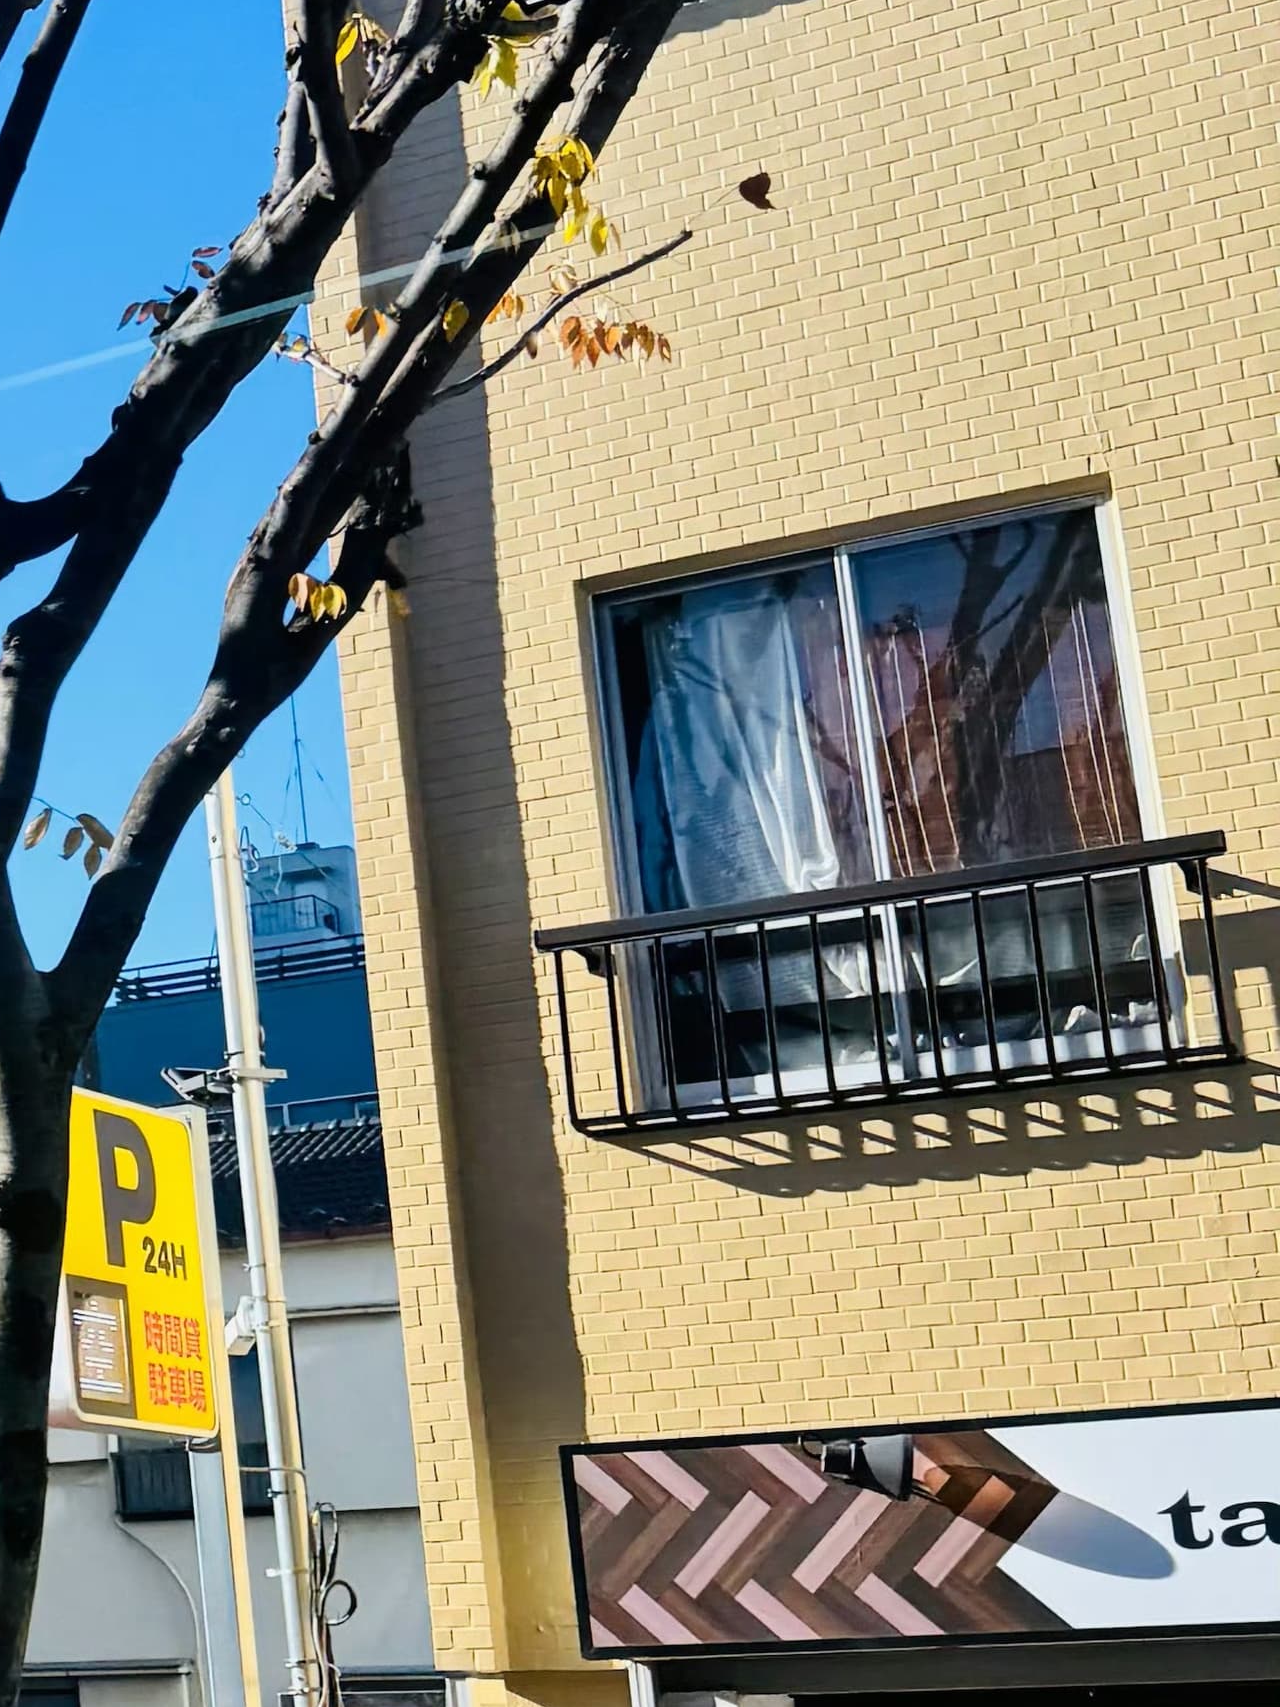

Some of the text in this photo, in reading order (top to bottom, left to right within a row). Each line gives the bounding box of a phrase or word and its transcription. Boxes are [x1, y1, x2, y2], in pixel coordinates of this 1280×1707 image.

[93, 1109, 156, 1268] P
[142, 1236, 188, 1281] 24H
[143, 1310, 203, 1361] 時間貸
[148, 1362, 208, 1414] 駐車場
[1157, 1489, 1280, 1550] ta
